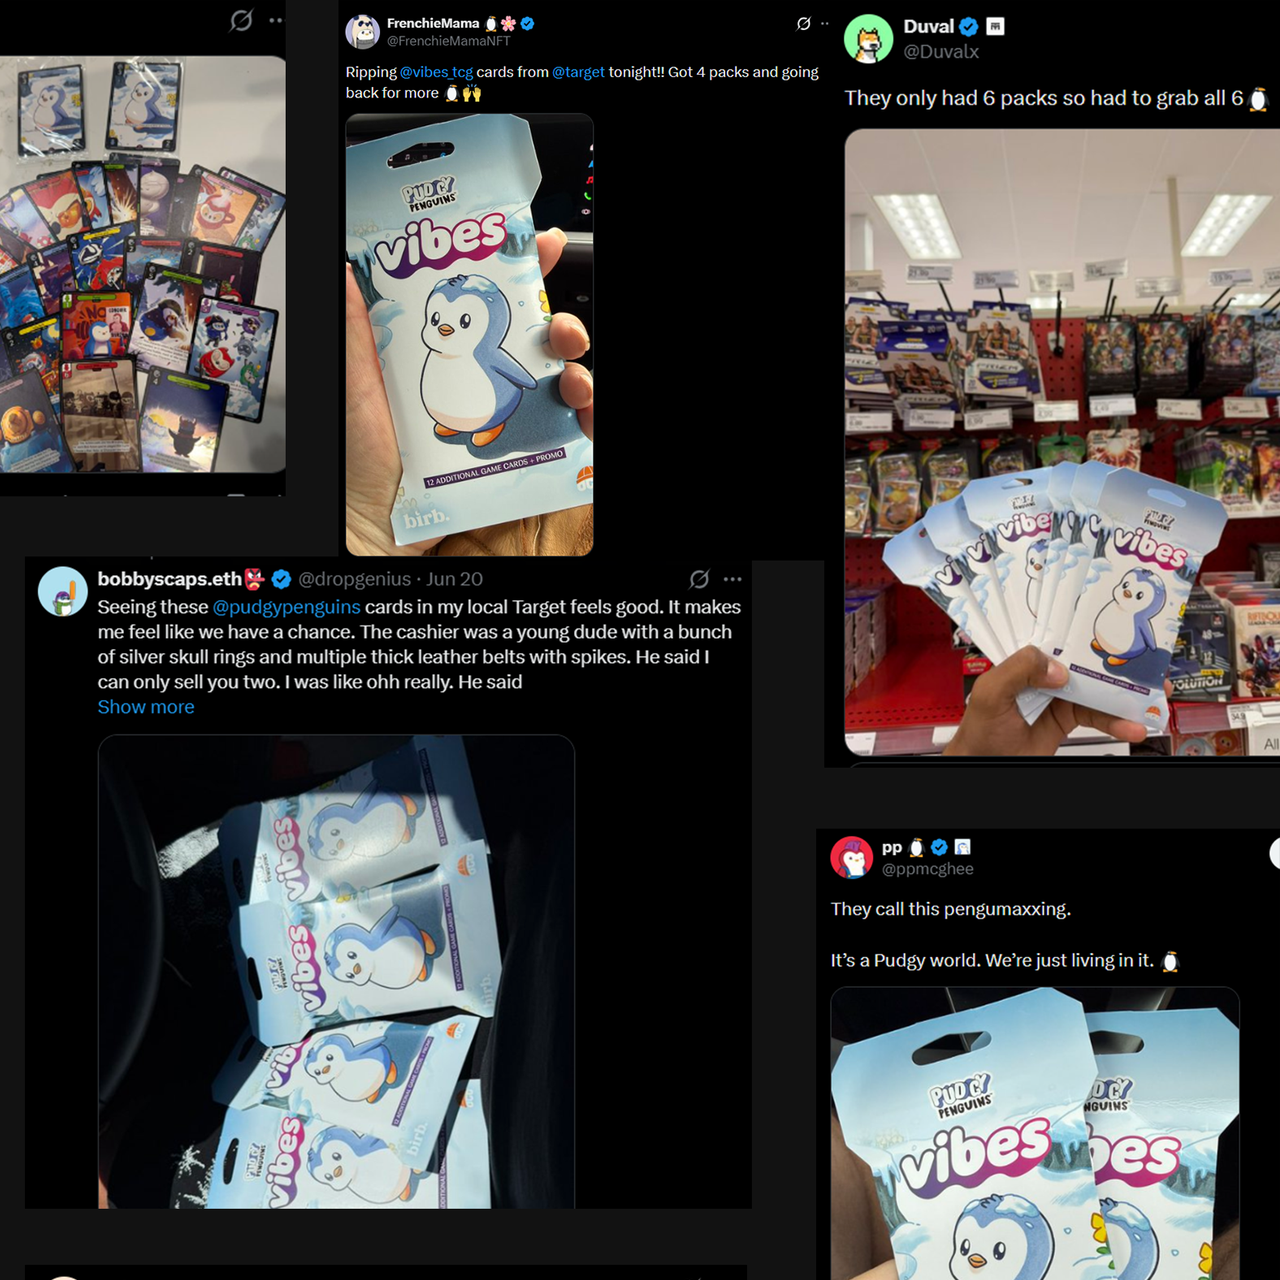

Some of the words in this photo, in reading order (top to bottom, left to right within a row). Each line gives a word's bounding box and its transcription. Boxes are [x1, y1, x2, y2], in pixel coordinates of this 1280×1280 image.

[409, 193, 456, 213] PENGUINS
[374, 212, 508, 279] vibes
[426, 478, 435, 487] 12
[435, 469, 479, 485] ADDITIONAL
[481, 464, 502, 475] GAME
[503, 458, 528, 471] CARDS
[535, 450, 563, 463] PROMO
[97, 698, 147, 715] Show
[150, 702, 195, 715] more
[830, 901, 873, 920] They
[875, 901, 905, 917] call
[907, 901, 941, 917] this
[943, 901, 1072, 920] pengumaxxing.
[938, 1093, 992, 1119] PENGUINS
[900, 1117, 1051, 1199] vibes
